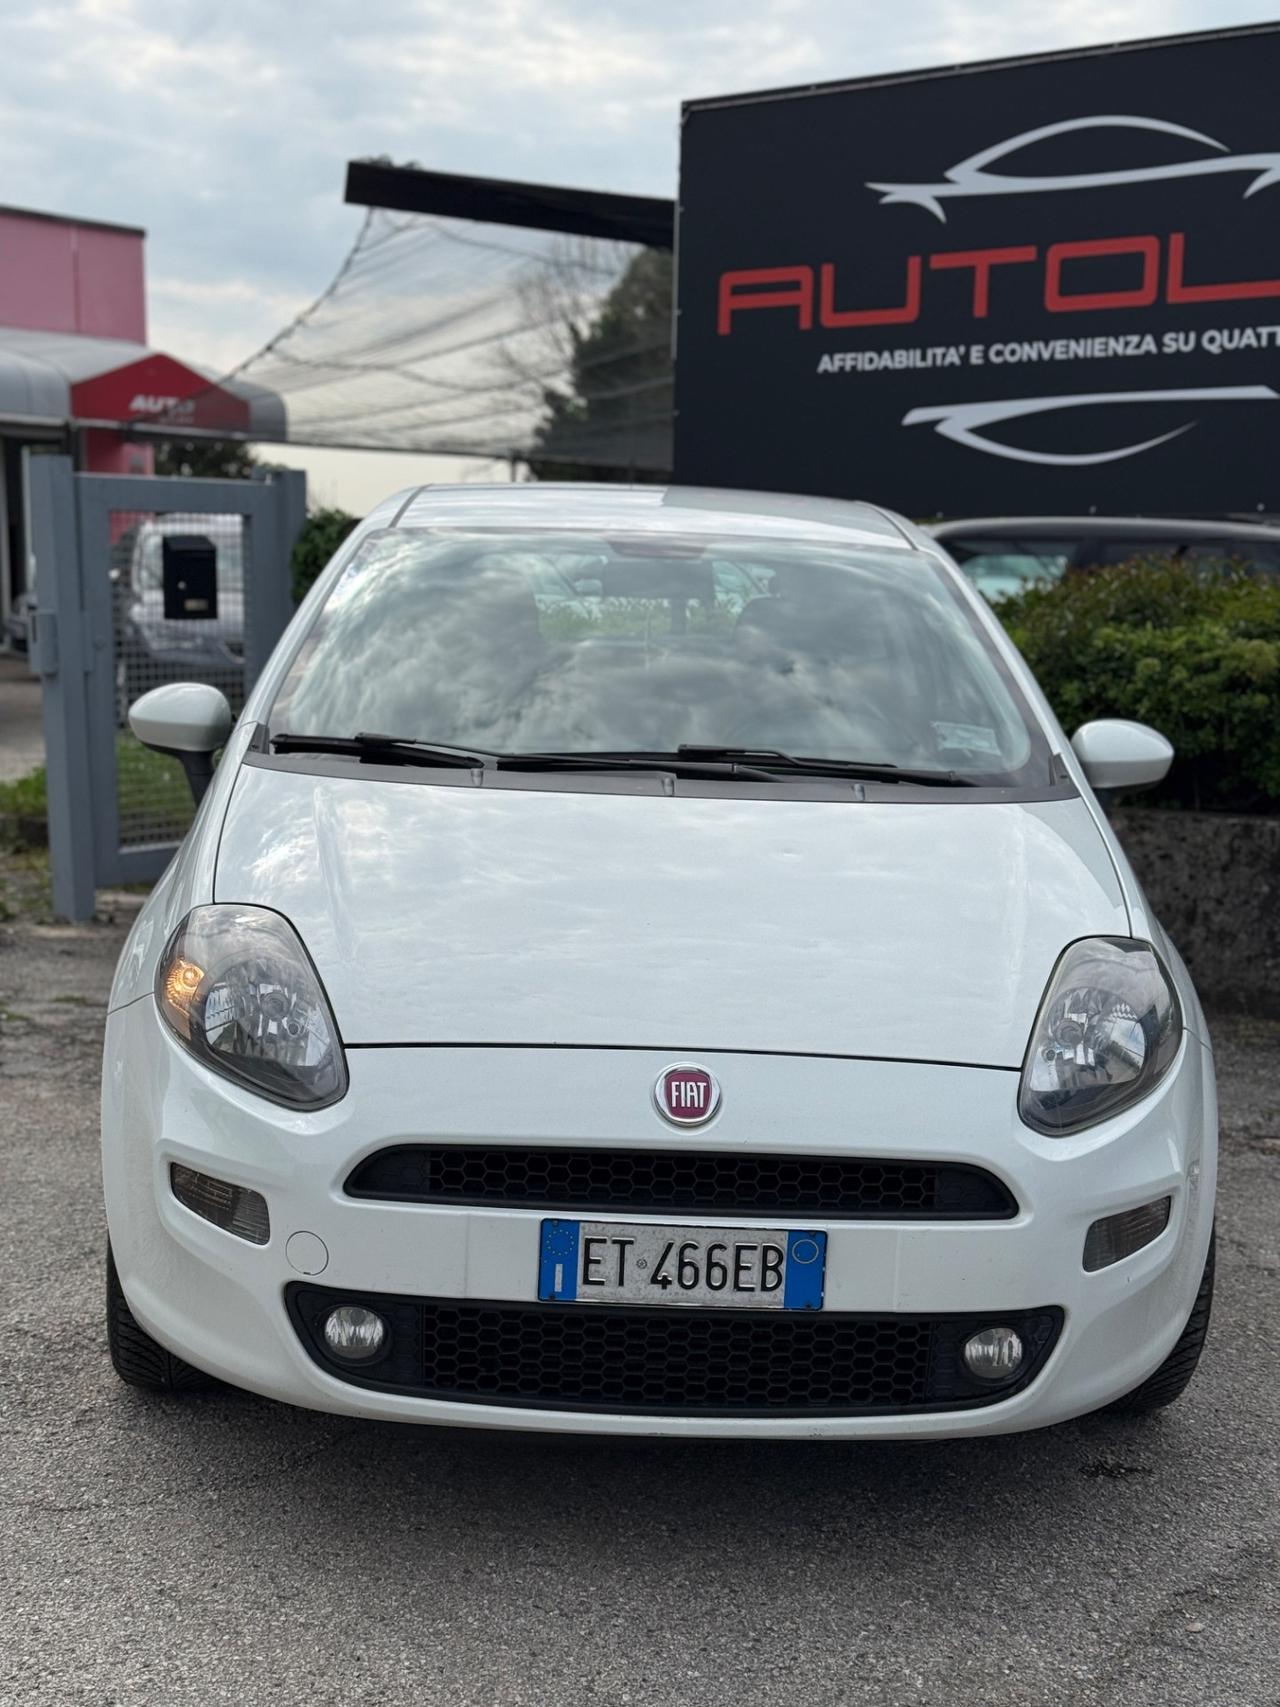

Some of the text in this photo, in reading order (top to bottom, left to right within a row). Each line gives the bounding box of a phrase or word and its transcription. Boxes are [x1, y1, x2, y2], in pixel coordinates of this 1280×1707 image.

[969, 344, 985, 365] E
[988, 334, 1158, 364] CONVENIENZA
[1162, 331, 1196, 354] SU
[671, 1081, 707, 1108] FIAT
